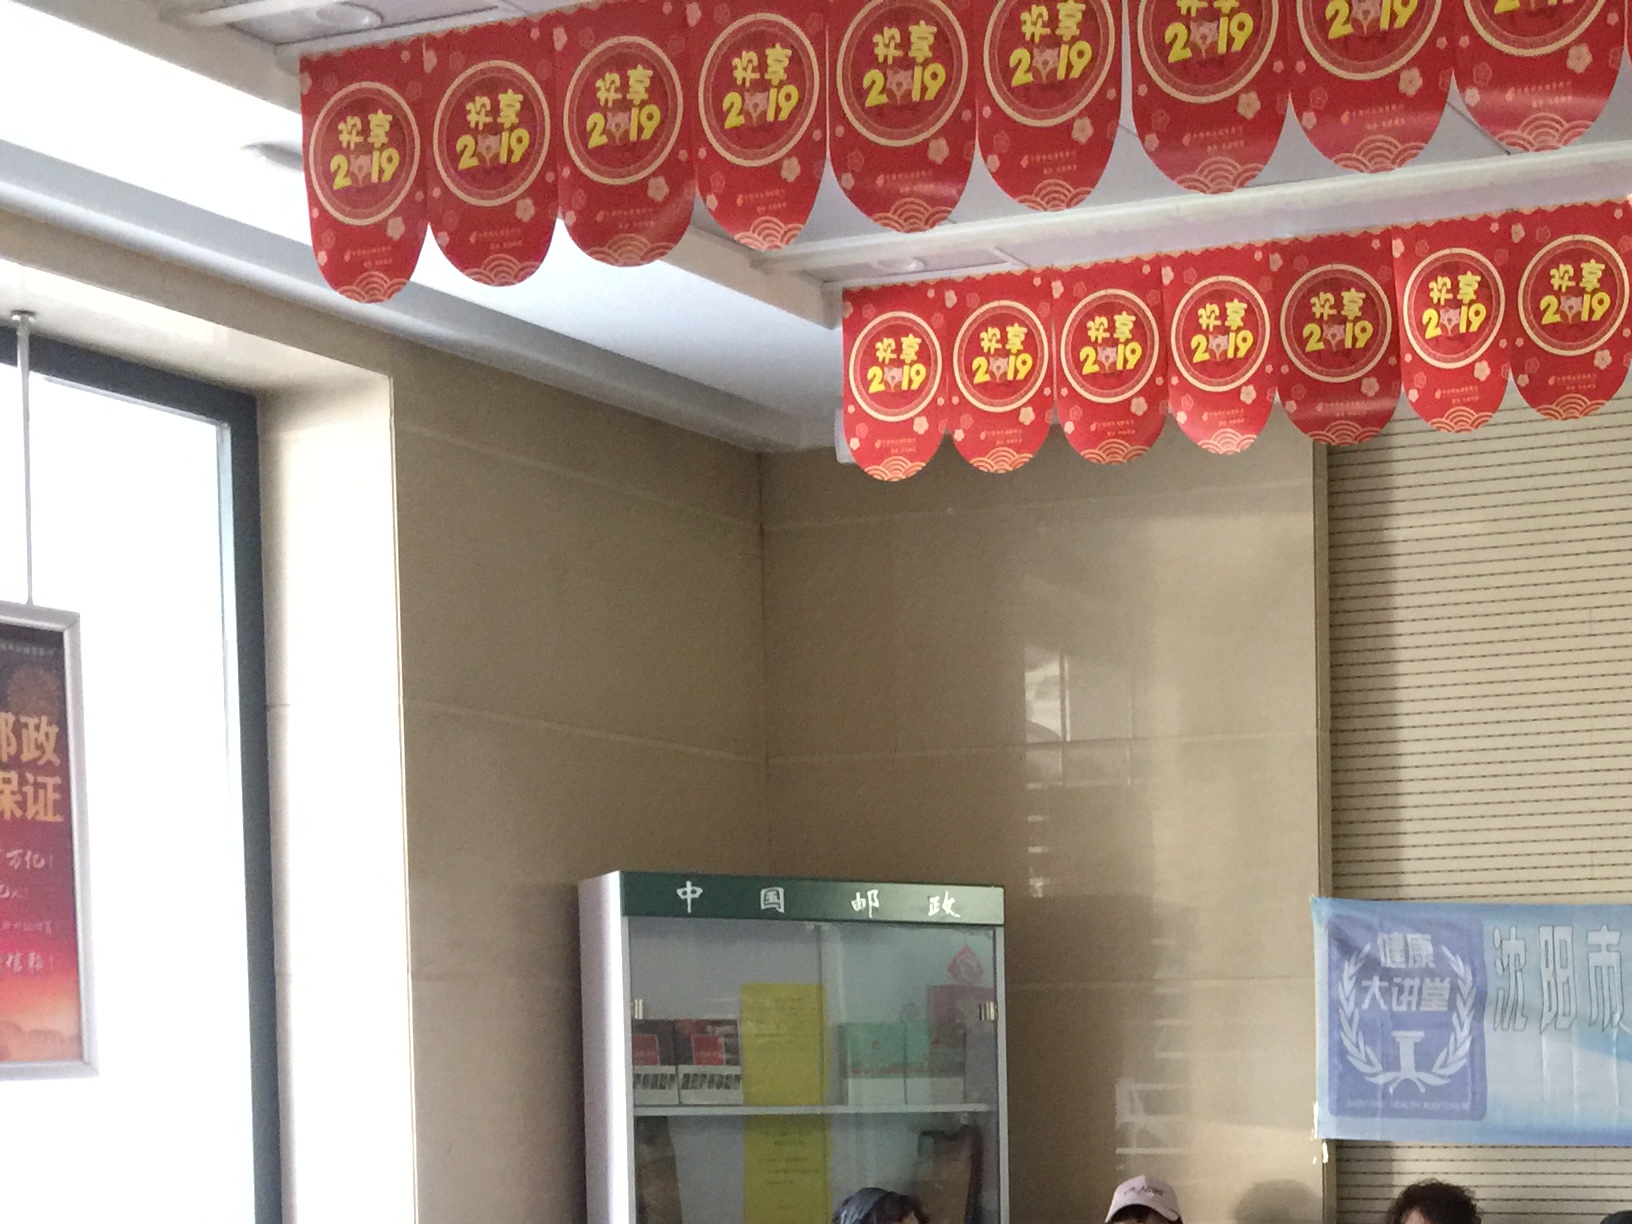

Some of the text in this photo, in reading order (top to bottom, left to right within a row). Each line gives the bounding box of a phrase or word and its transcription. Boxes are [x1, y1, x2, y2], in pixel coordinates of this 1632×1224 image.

[676, 880, 962, 919] 中国邮政
[1376, 930, 1437, 970] 健康
[1360, 974, 1453, 1014] 大讲堂
